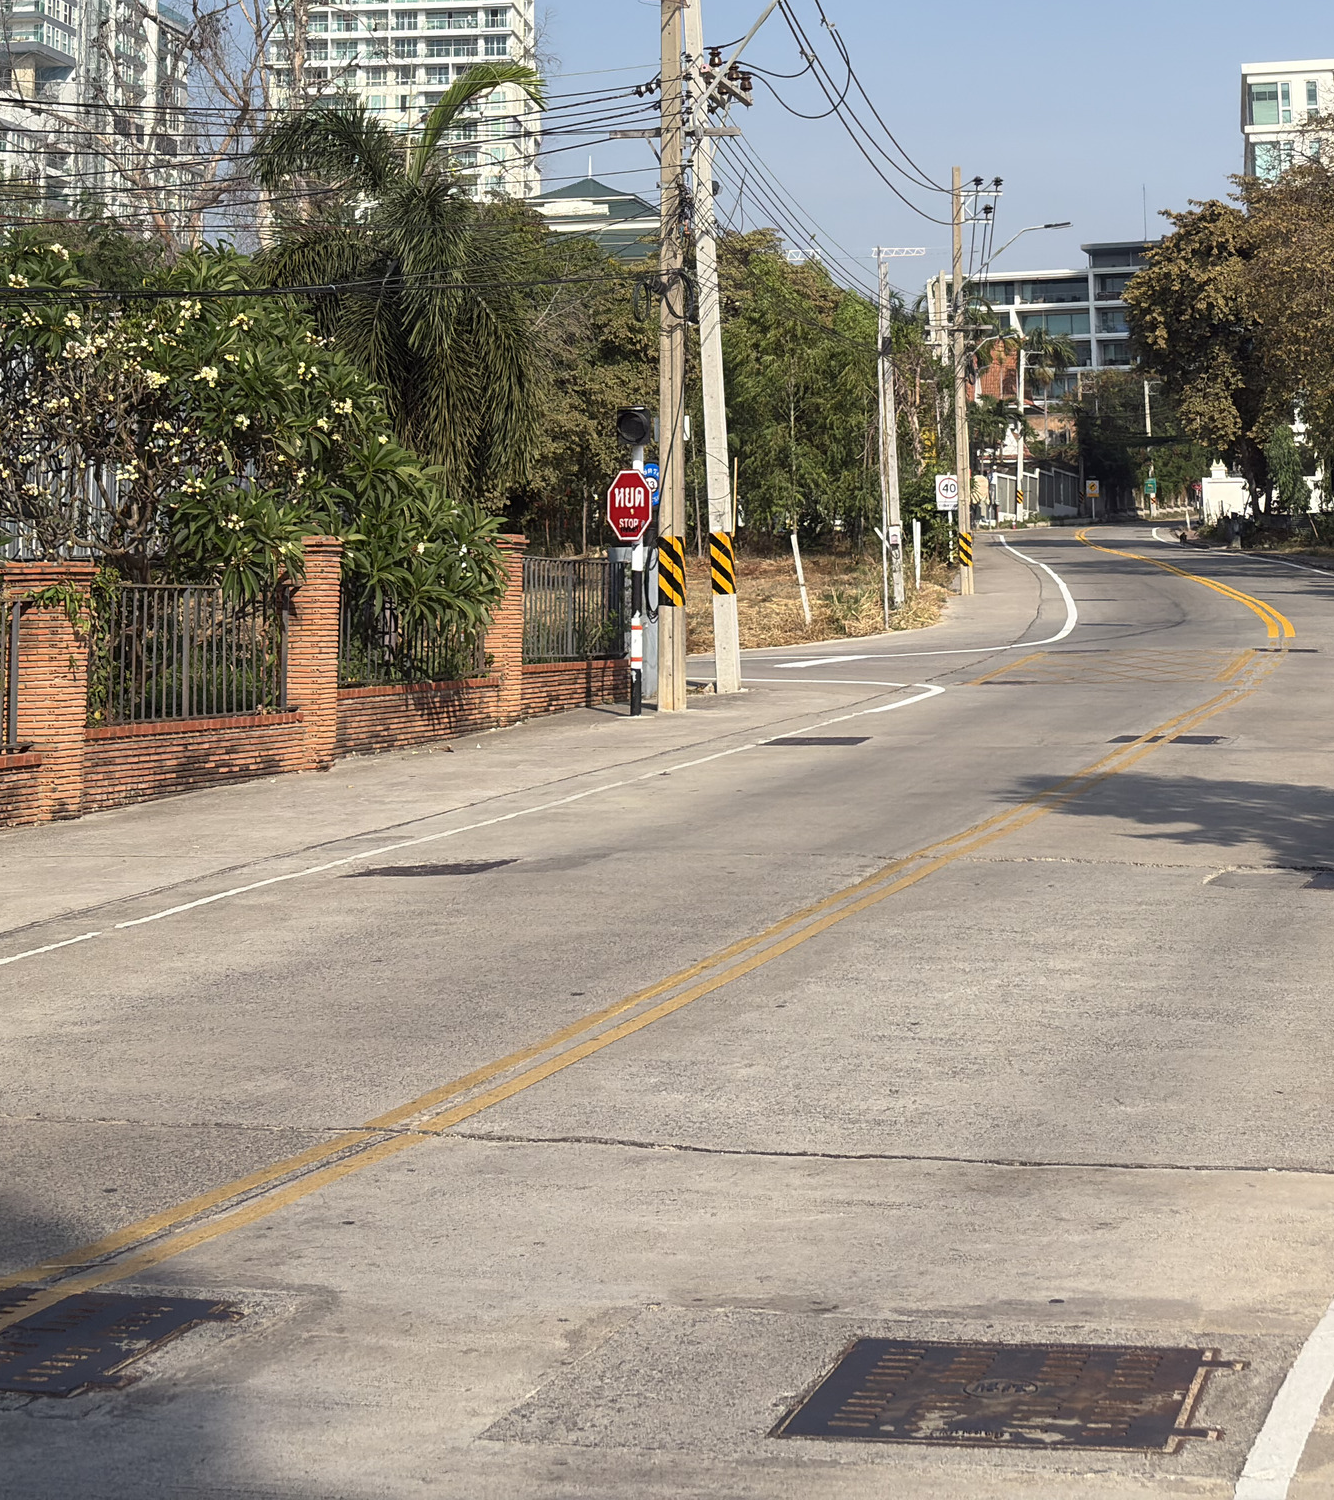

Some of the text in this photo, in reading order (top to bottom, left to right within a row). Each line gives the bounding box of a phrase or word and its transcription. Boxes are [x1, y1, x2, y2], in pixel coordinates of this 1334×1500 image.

[942, 483, 956, 493] 40
[614, 487, 645, 508] หยด
[619, 518, 639, 529] STOP
